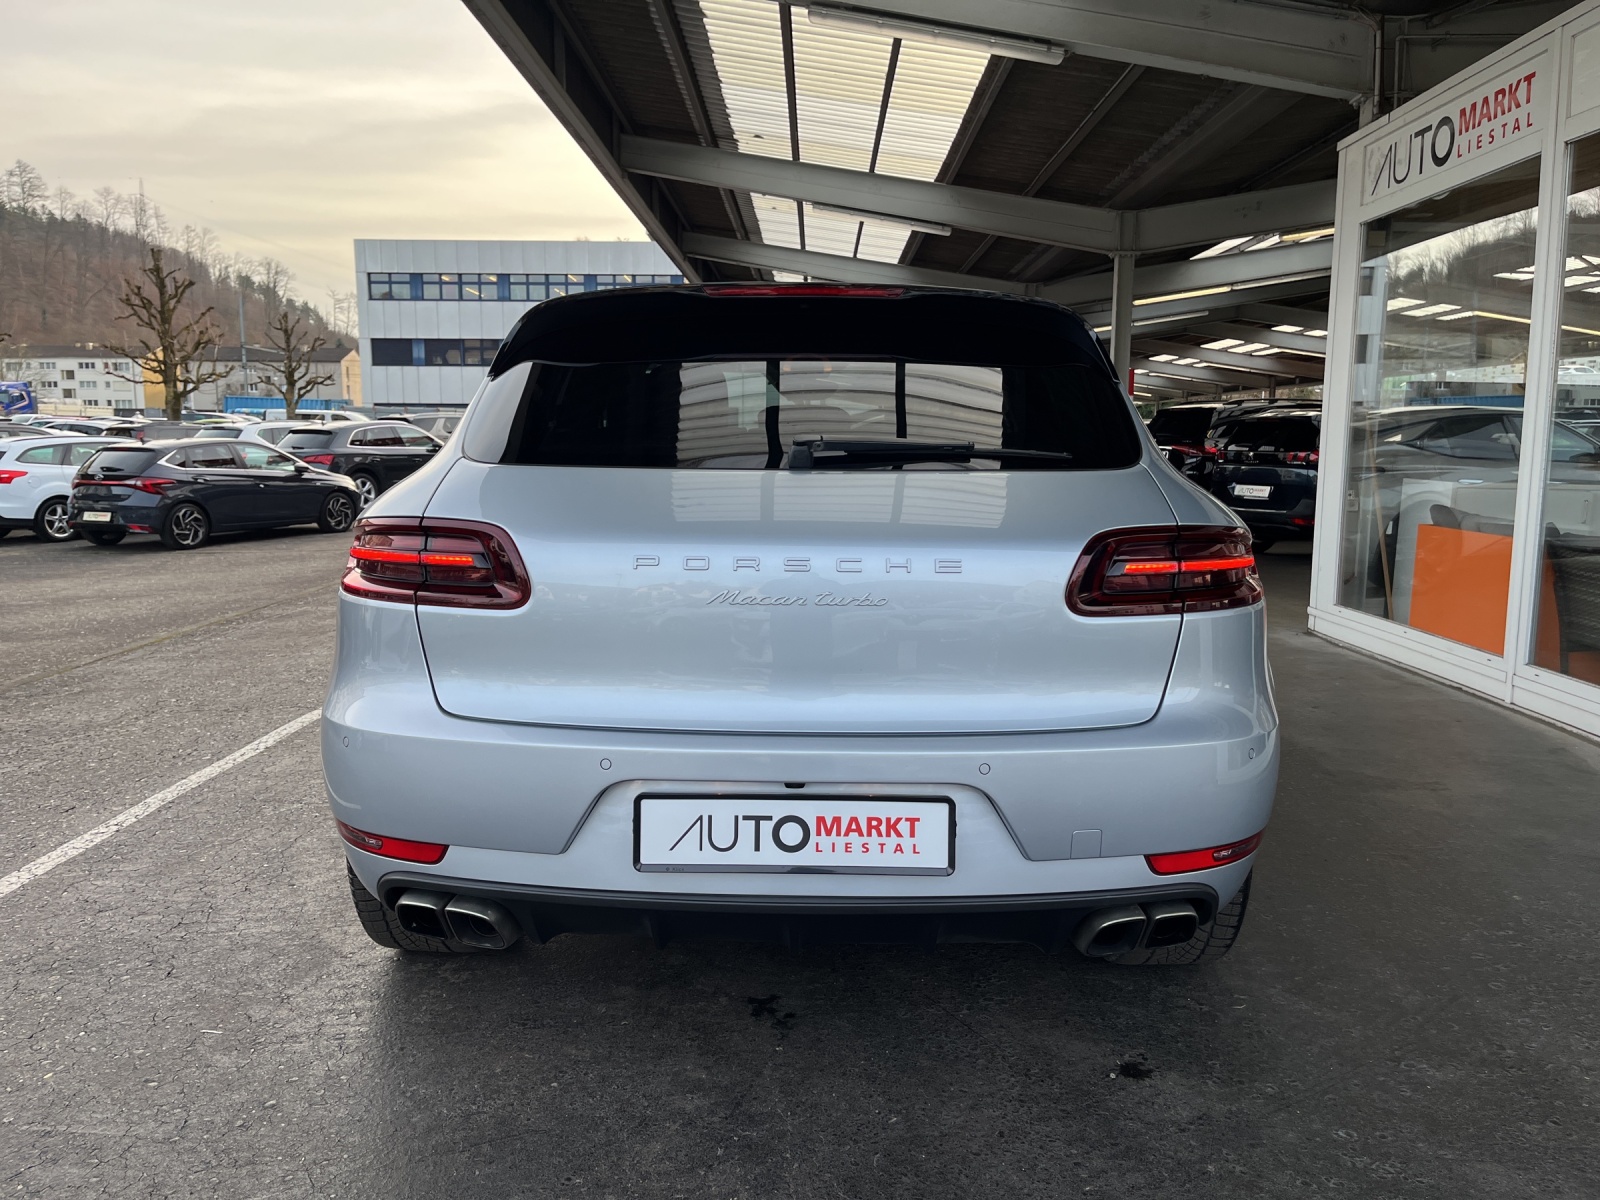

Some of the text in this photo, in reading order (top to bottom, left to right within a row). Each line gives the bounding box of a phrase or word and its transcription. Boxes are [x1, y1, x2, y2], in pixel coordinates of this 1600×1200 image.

[1457, 112, 1533, 158] LIESTAL
[633, 555, 962, 573] PORSCHE
[706, 589, 889, 607] Macan turbo
[815, 842, 921, 854] LIESTAL
